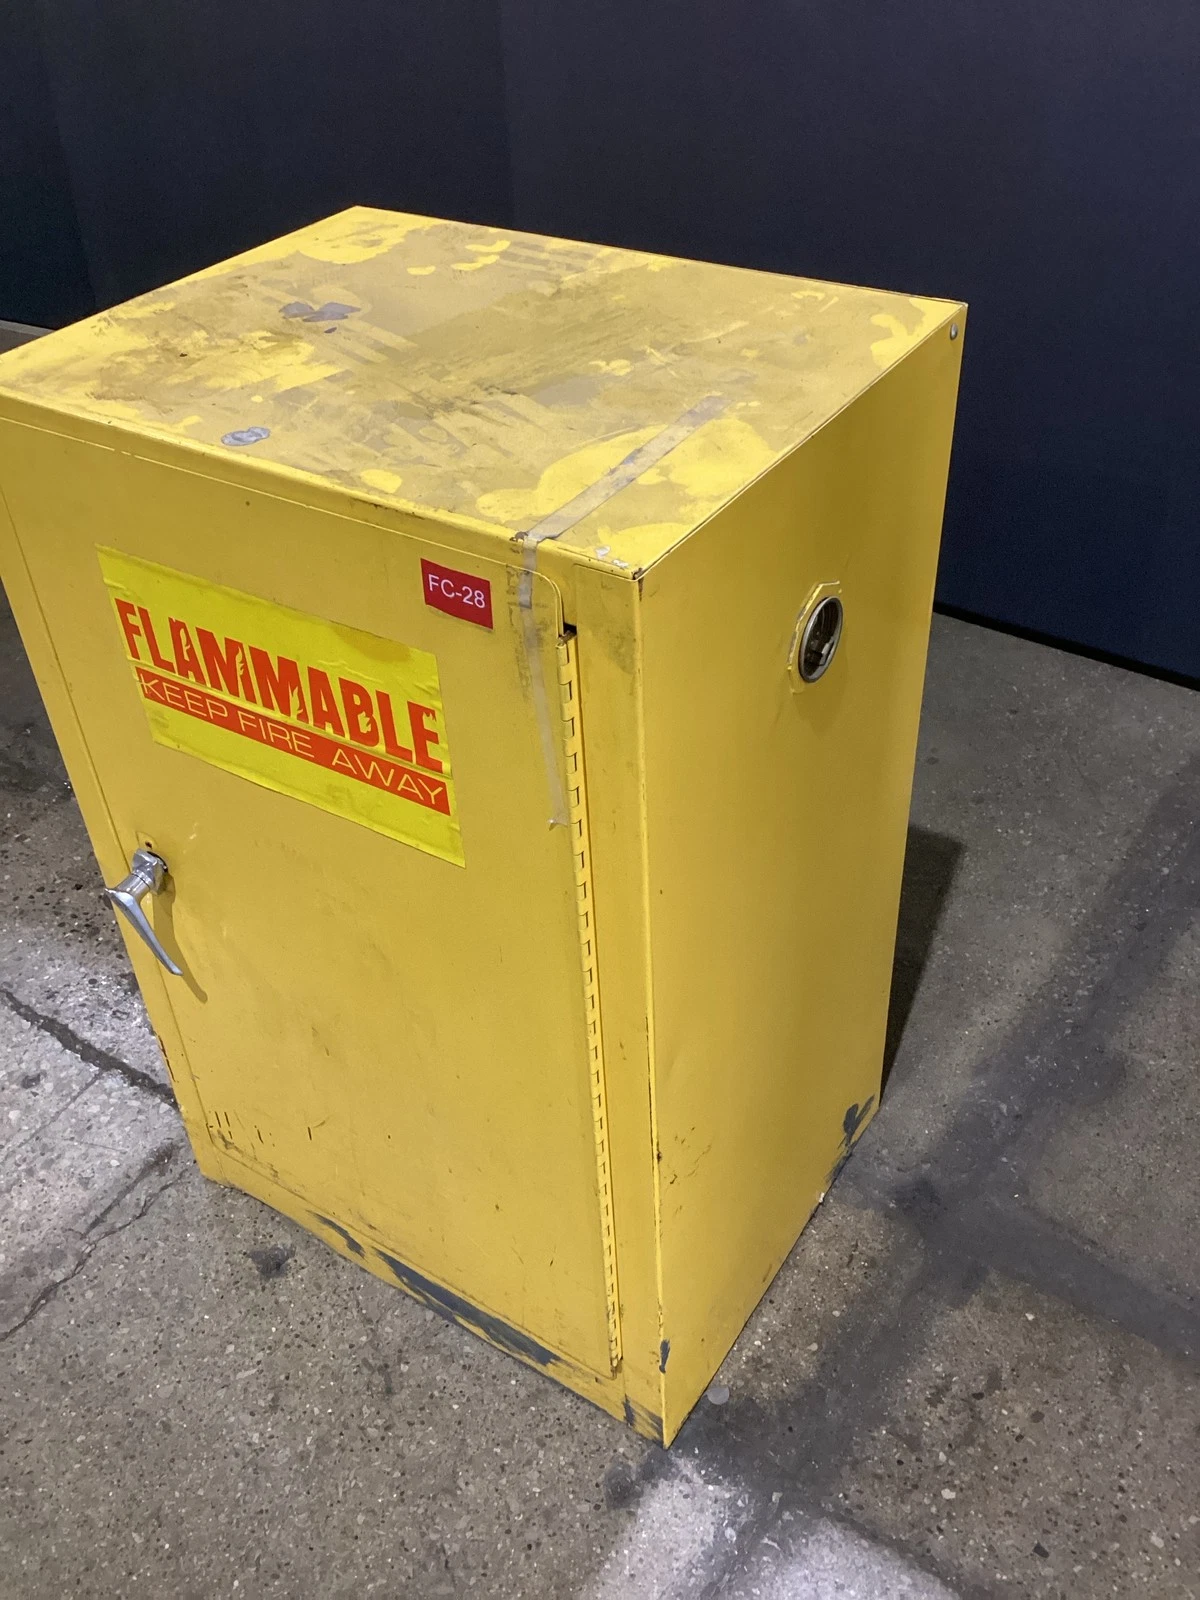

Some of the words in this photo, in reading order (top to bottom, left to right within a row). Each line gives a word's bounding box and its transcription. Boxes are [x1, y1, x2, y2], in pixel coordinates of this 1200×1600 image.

[428, 573, 486, 609] FC-28
[114, 597, 444, 774] FLAMMABLE
[139, 673, 229, 720] KEEP
[236, 709, 316, 759] FIRE
[331, 748, 444, 805] AWAY
